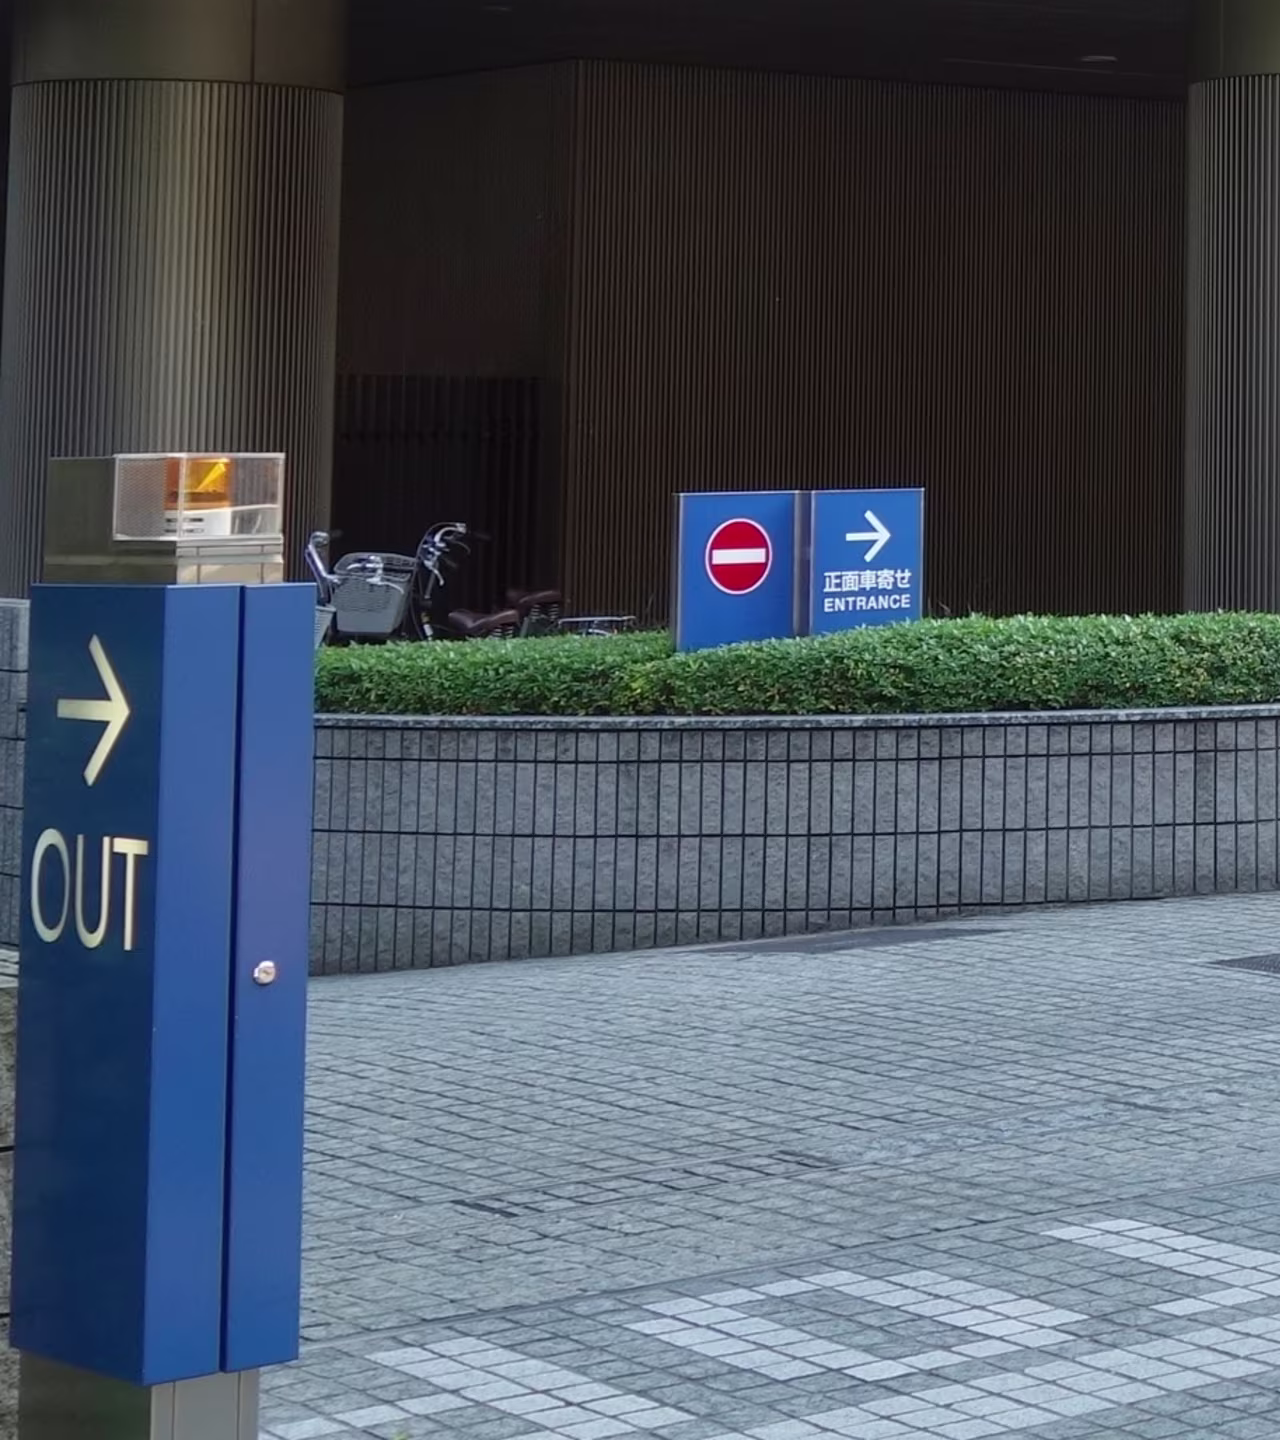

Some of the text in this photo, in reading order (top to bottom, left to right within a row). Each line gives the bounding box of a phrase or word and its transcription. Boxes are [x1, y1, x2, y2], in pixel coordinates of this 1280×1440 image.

[824, 569, 911, 592] 正面車寄せ
[824, 594, 911, 612] ENTRANCE
[30, 827, 149, 951] OUT
